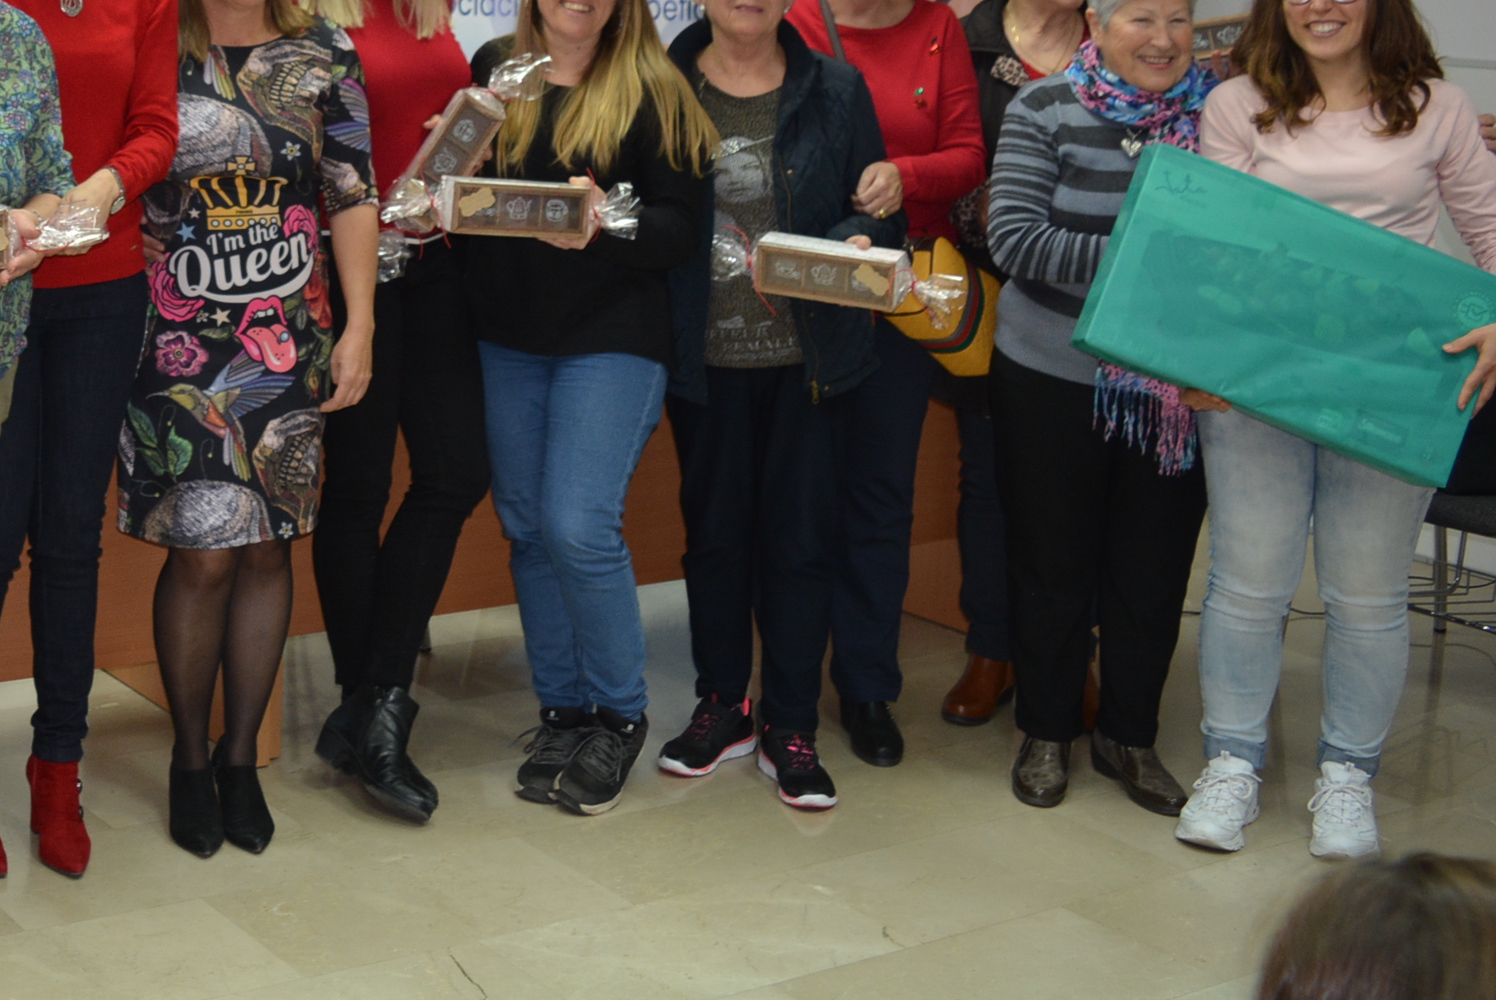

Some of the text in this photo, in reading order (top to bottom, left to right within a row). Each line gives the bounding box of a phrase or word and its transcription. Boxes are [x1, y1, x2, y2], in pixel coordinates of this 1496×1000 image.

[207, 223, 279, 255] I'm the
[169, 234, 315, 304] Queen
